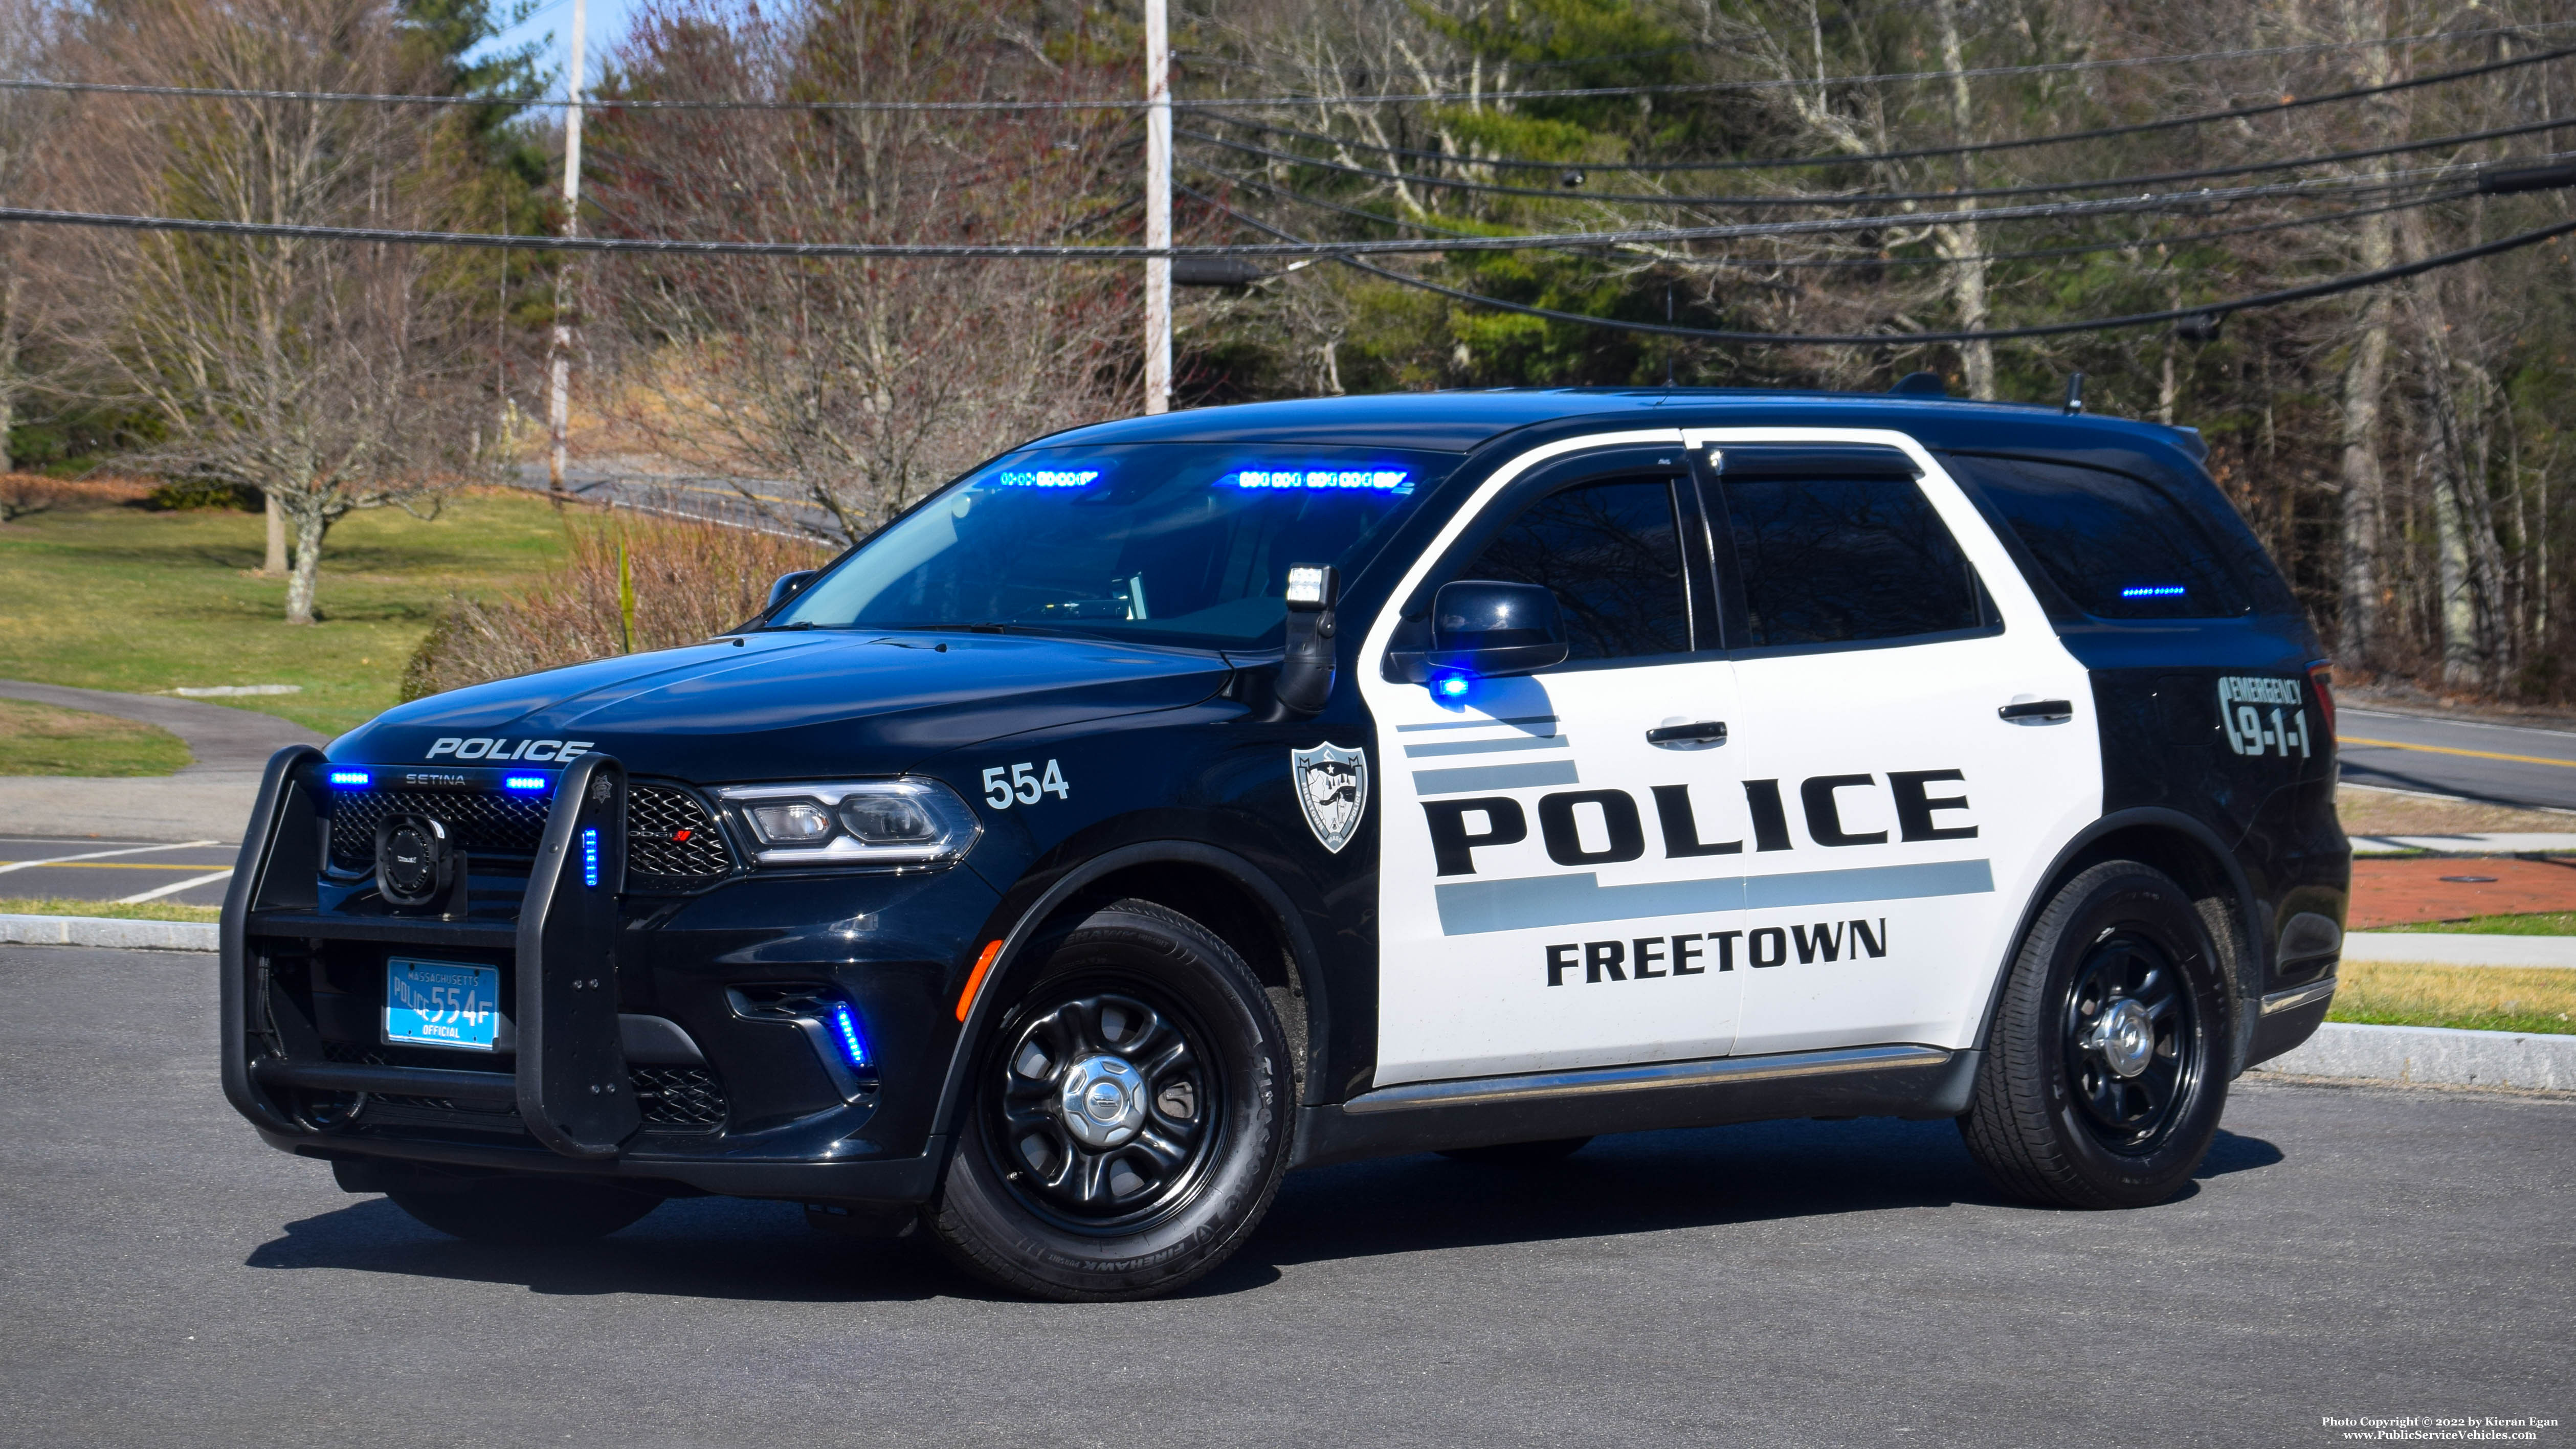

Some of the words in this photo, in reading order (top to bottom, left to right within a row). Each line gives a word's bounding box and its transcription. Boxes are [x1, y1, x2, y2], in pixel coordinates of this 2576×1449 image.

[2229, 676, 2302, 705] EMERGENCY
[2238, 706, 2310, 758] 9-1-1
[425, 738, 595, 762] POLICE
[406, 773, 466, 786] SETINA
[982, 759, 1070, 810] 554
[1349, 791, 1362, 822] POLICE
[1420, 769, 1979, 877] POLICE
[1545, 918, 1887, 987] FREETOWN
[408, 971, 479, 987] MASSACHUSETTS
[394, 976, 429, 1021] POLICE
[431, 986, 493, 1027] 554F
[423, 1024, 460, 1038] OFFICIAL
[1083, 1241, 1186, 1272] FIREHAWK
